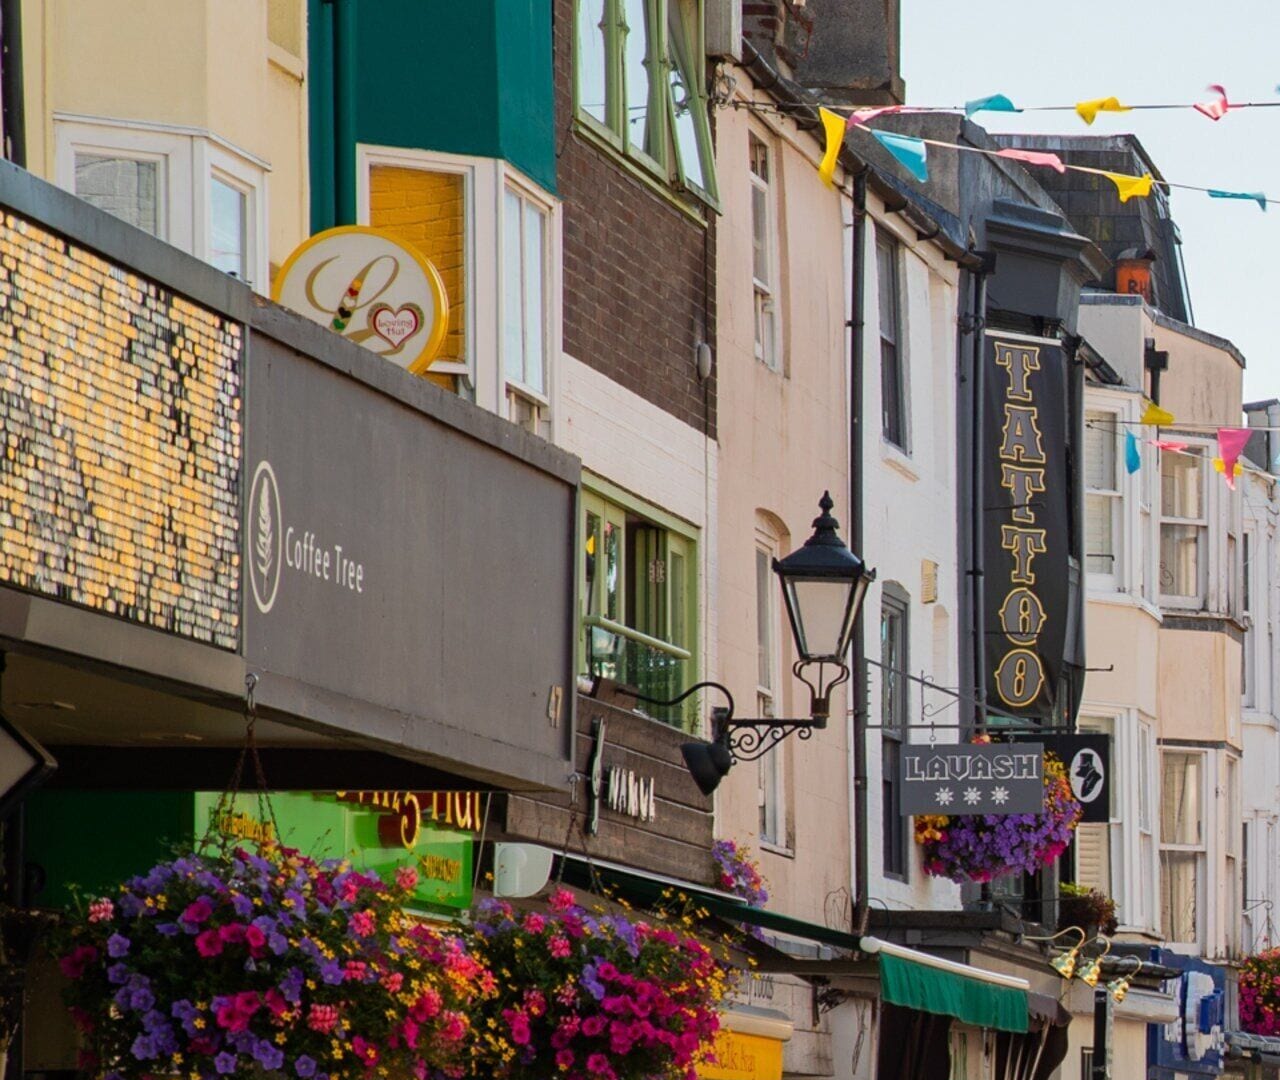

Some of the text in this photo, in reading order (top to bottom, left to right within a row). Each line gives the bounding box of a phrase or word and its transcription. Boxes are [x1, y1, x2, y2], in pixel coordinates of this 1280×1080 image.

[378, 319, 413, 331] Loving
[386, 326, 405, 337] Hut
[994, 341, 1047, 707] TATTOO
[285, 526, 364, 593] Coffee Tree
[904, 754, 1039, 782] LAVASH
